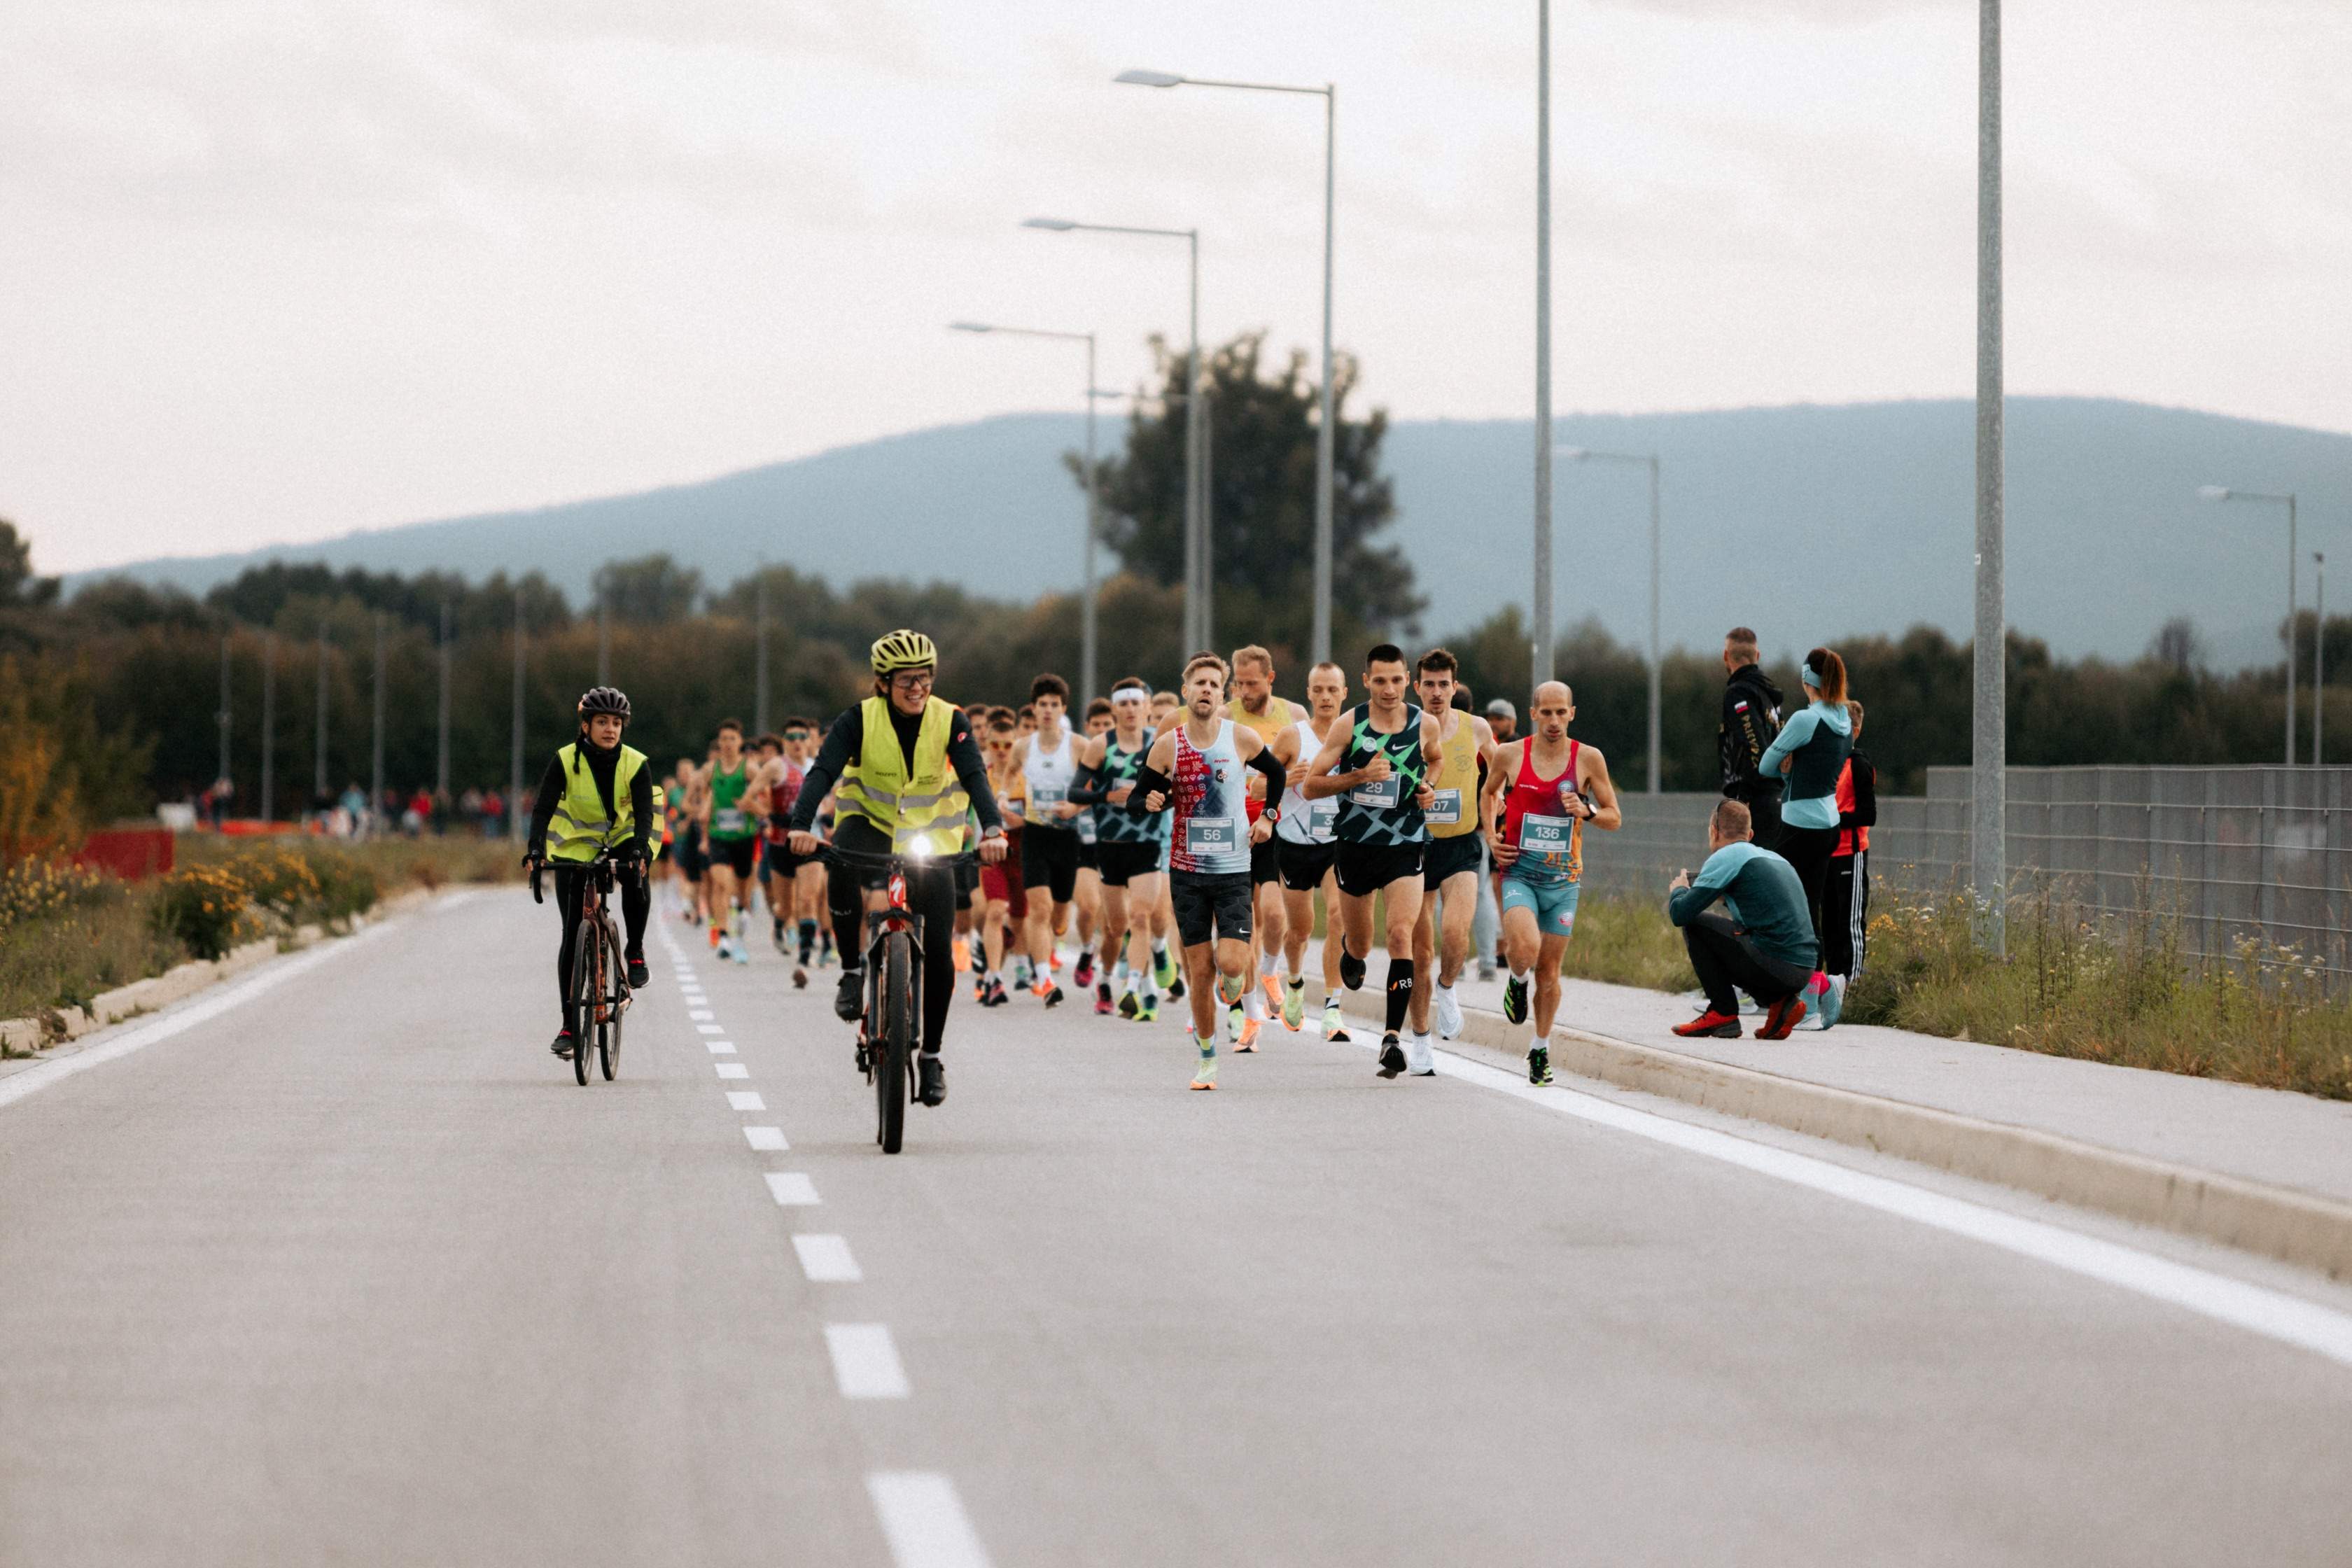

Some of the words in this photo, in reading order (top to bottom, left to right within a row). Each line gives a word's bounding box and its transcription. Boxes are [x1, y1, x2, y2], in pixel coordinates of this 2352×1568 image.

[1366, 782, 1382, 793] 29
[1203, 829, 1222, 841] 56
[1535, 827, 1560, 839] 136
[1399, 978, 1413, 989] RB
